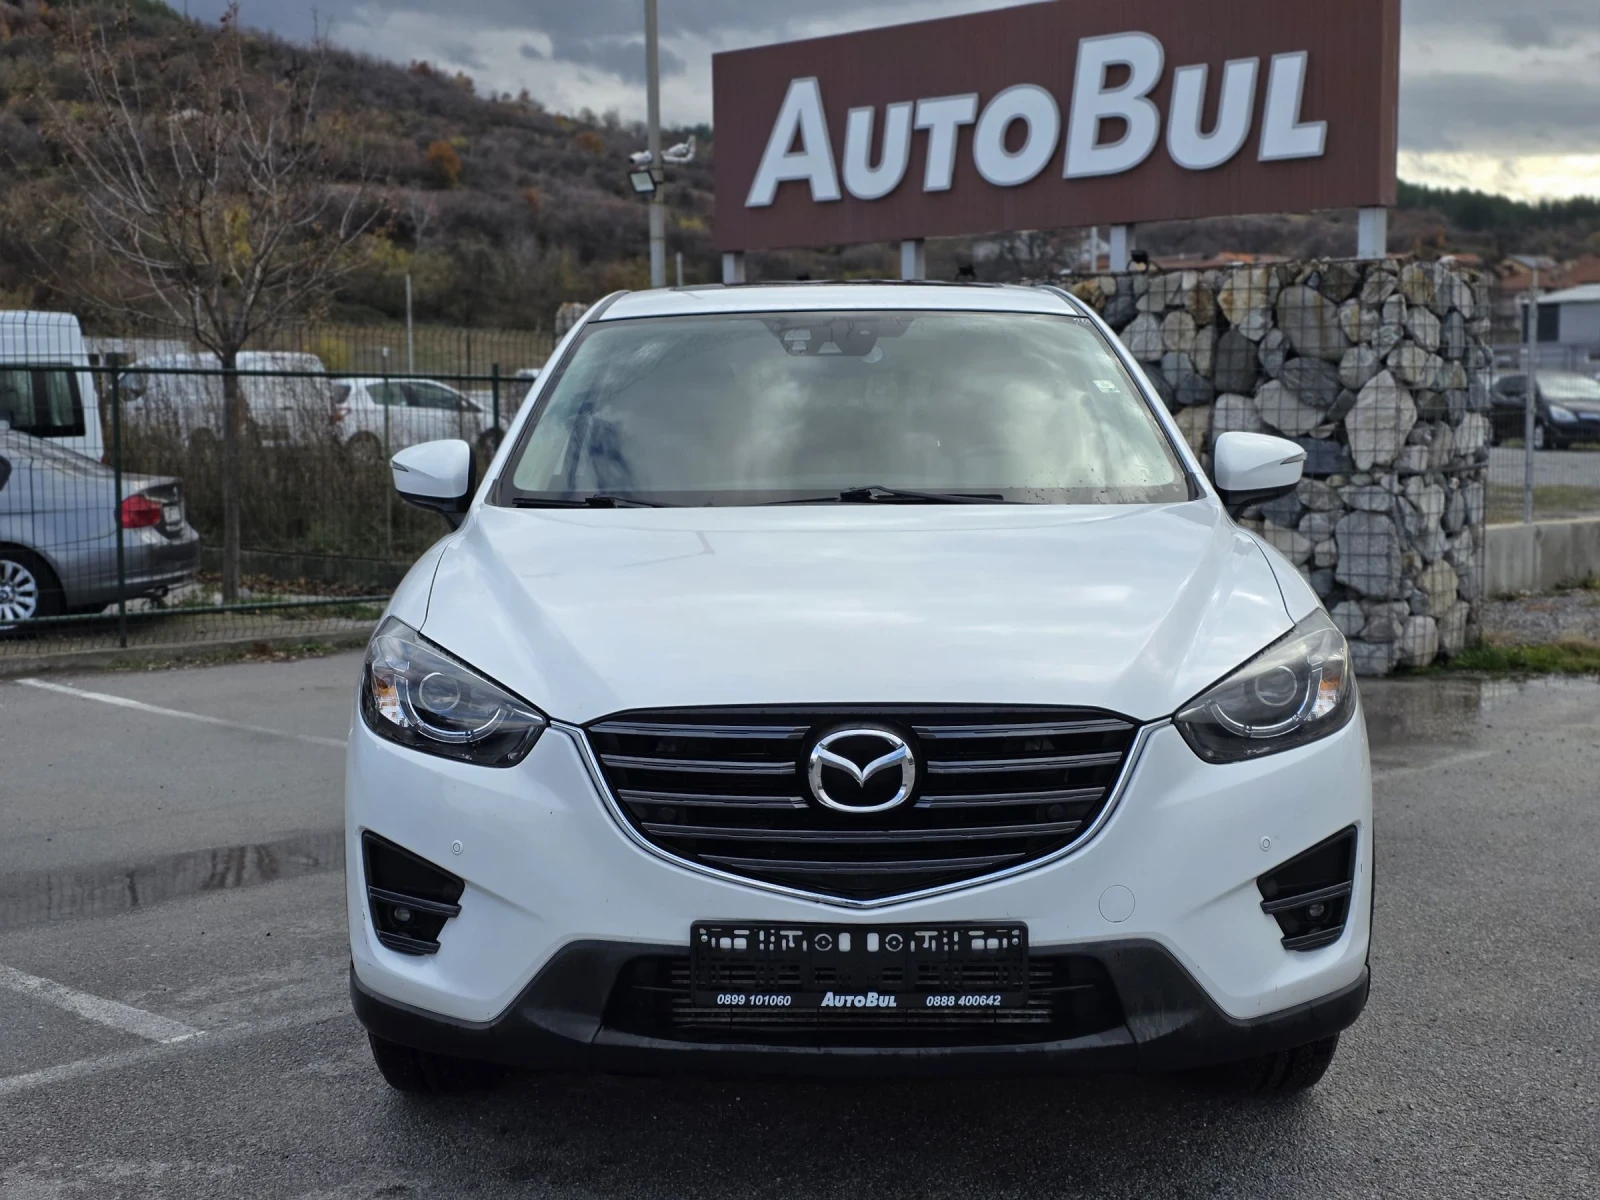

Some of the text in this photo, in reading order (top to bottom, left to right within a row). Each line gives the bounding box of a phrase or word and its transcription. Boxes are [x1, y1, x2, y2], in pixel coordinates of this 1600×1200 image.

[717, 994, 791, 1006] 0899 101060
[926, 995, 1001, 1006] 0888 400642
